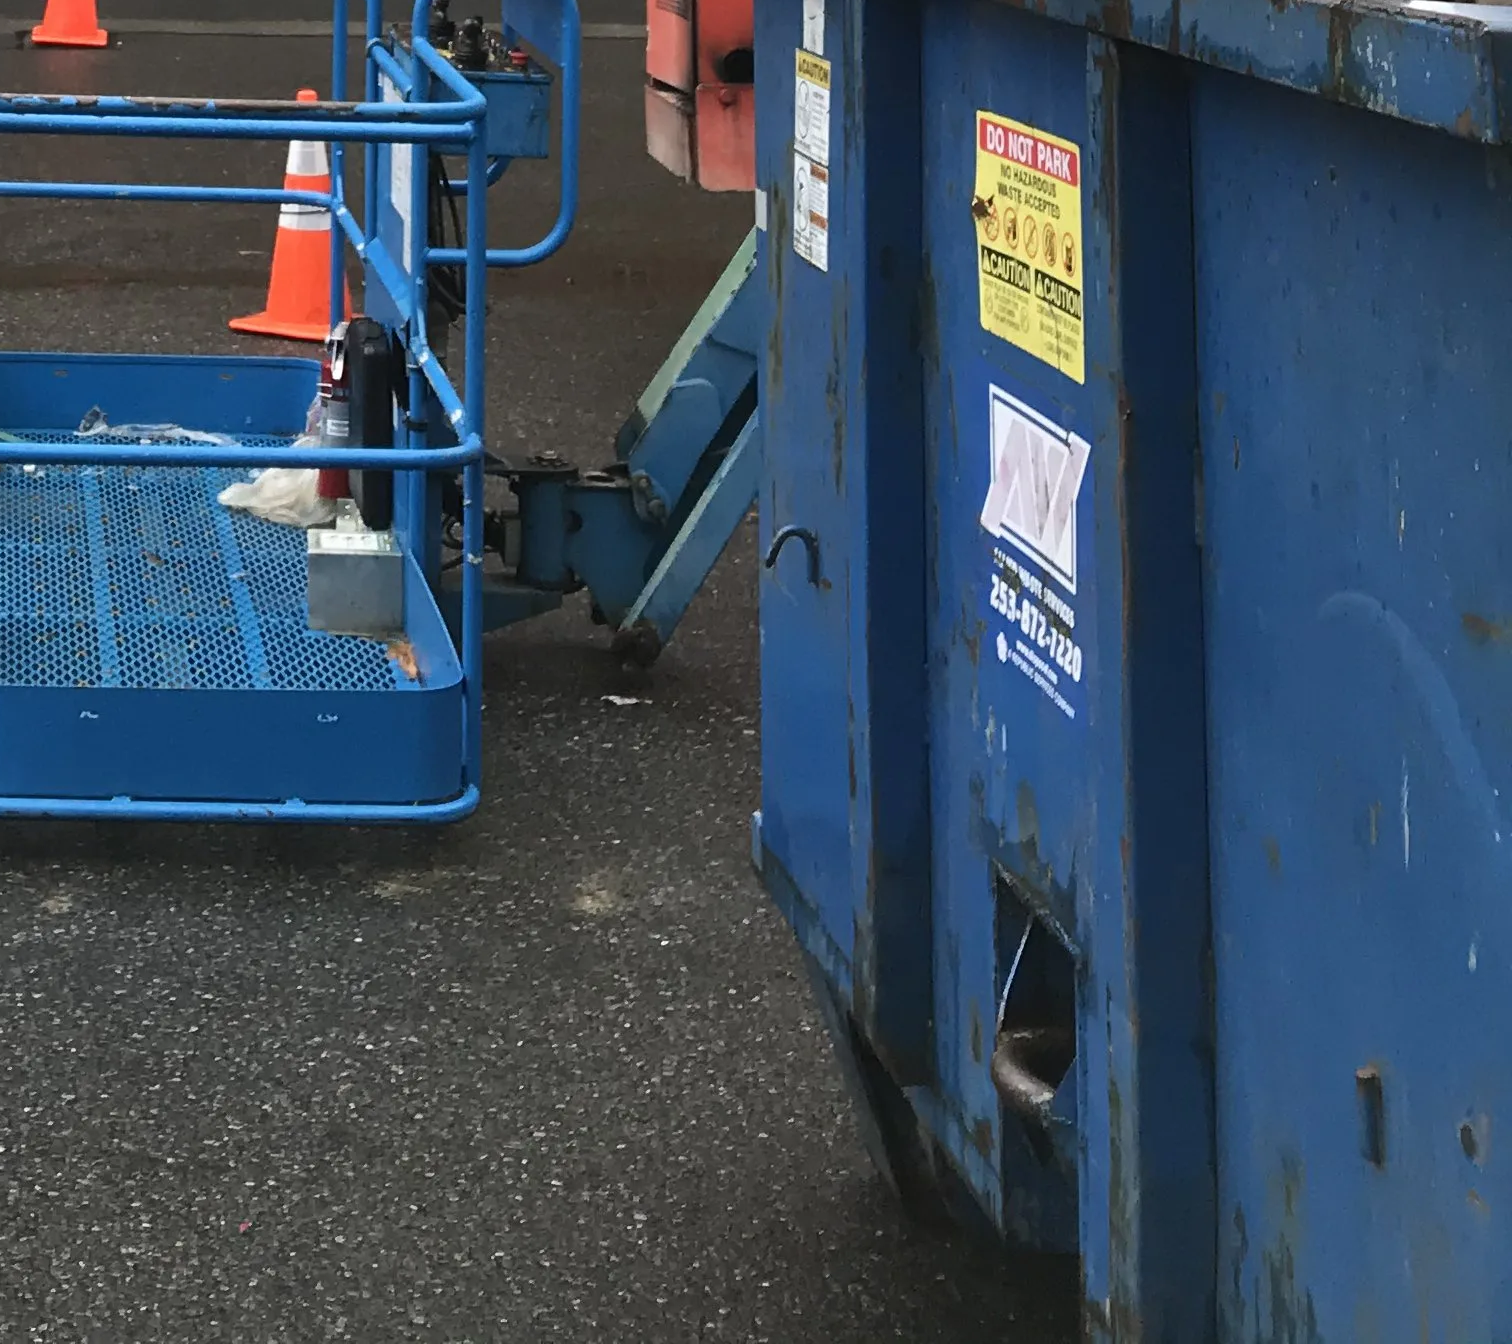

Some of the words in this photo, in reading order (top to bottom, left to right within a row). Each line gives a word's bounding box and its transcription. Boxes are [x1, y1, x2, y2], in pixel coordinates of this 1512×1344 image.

[986, 123, 1005, 154] DO
[1008, 131, 1034, 166] NOT
[1036, 141, 1072, 181] PARK
[1000, 163, 1011, 180] NO
[1013, 168, 1057, 198] HAZARDOUS
[997, 182, 1022, 204] WASTE
[1024, 192, 1061, 220] ACCEPTED
[990, 253, 1031, 290] CAUTION
[1044, 278, 1082, 317] CAUTION
